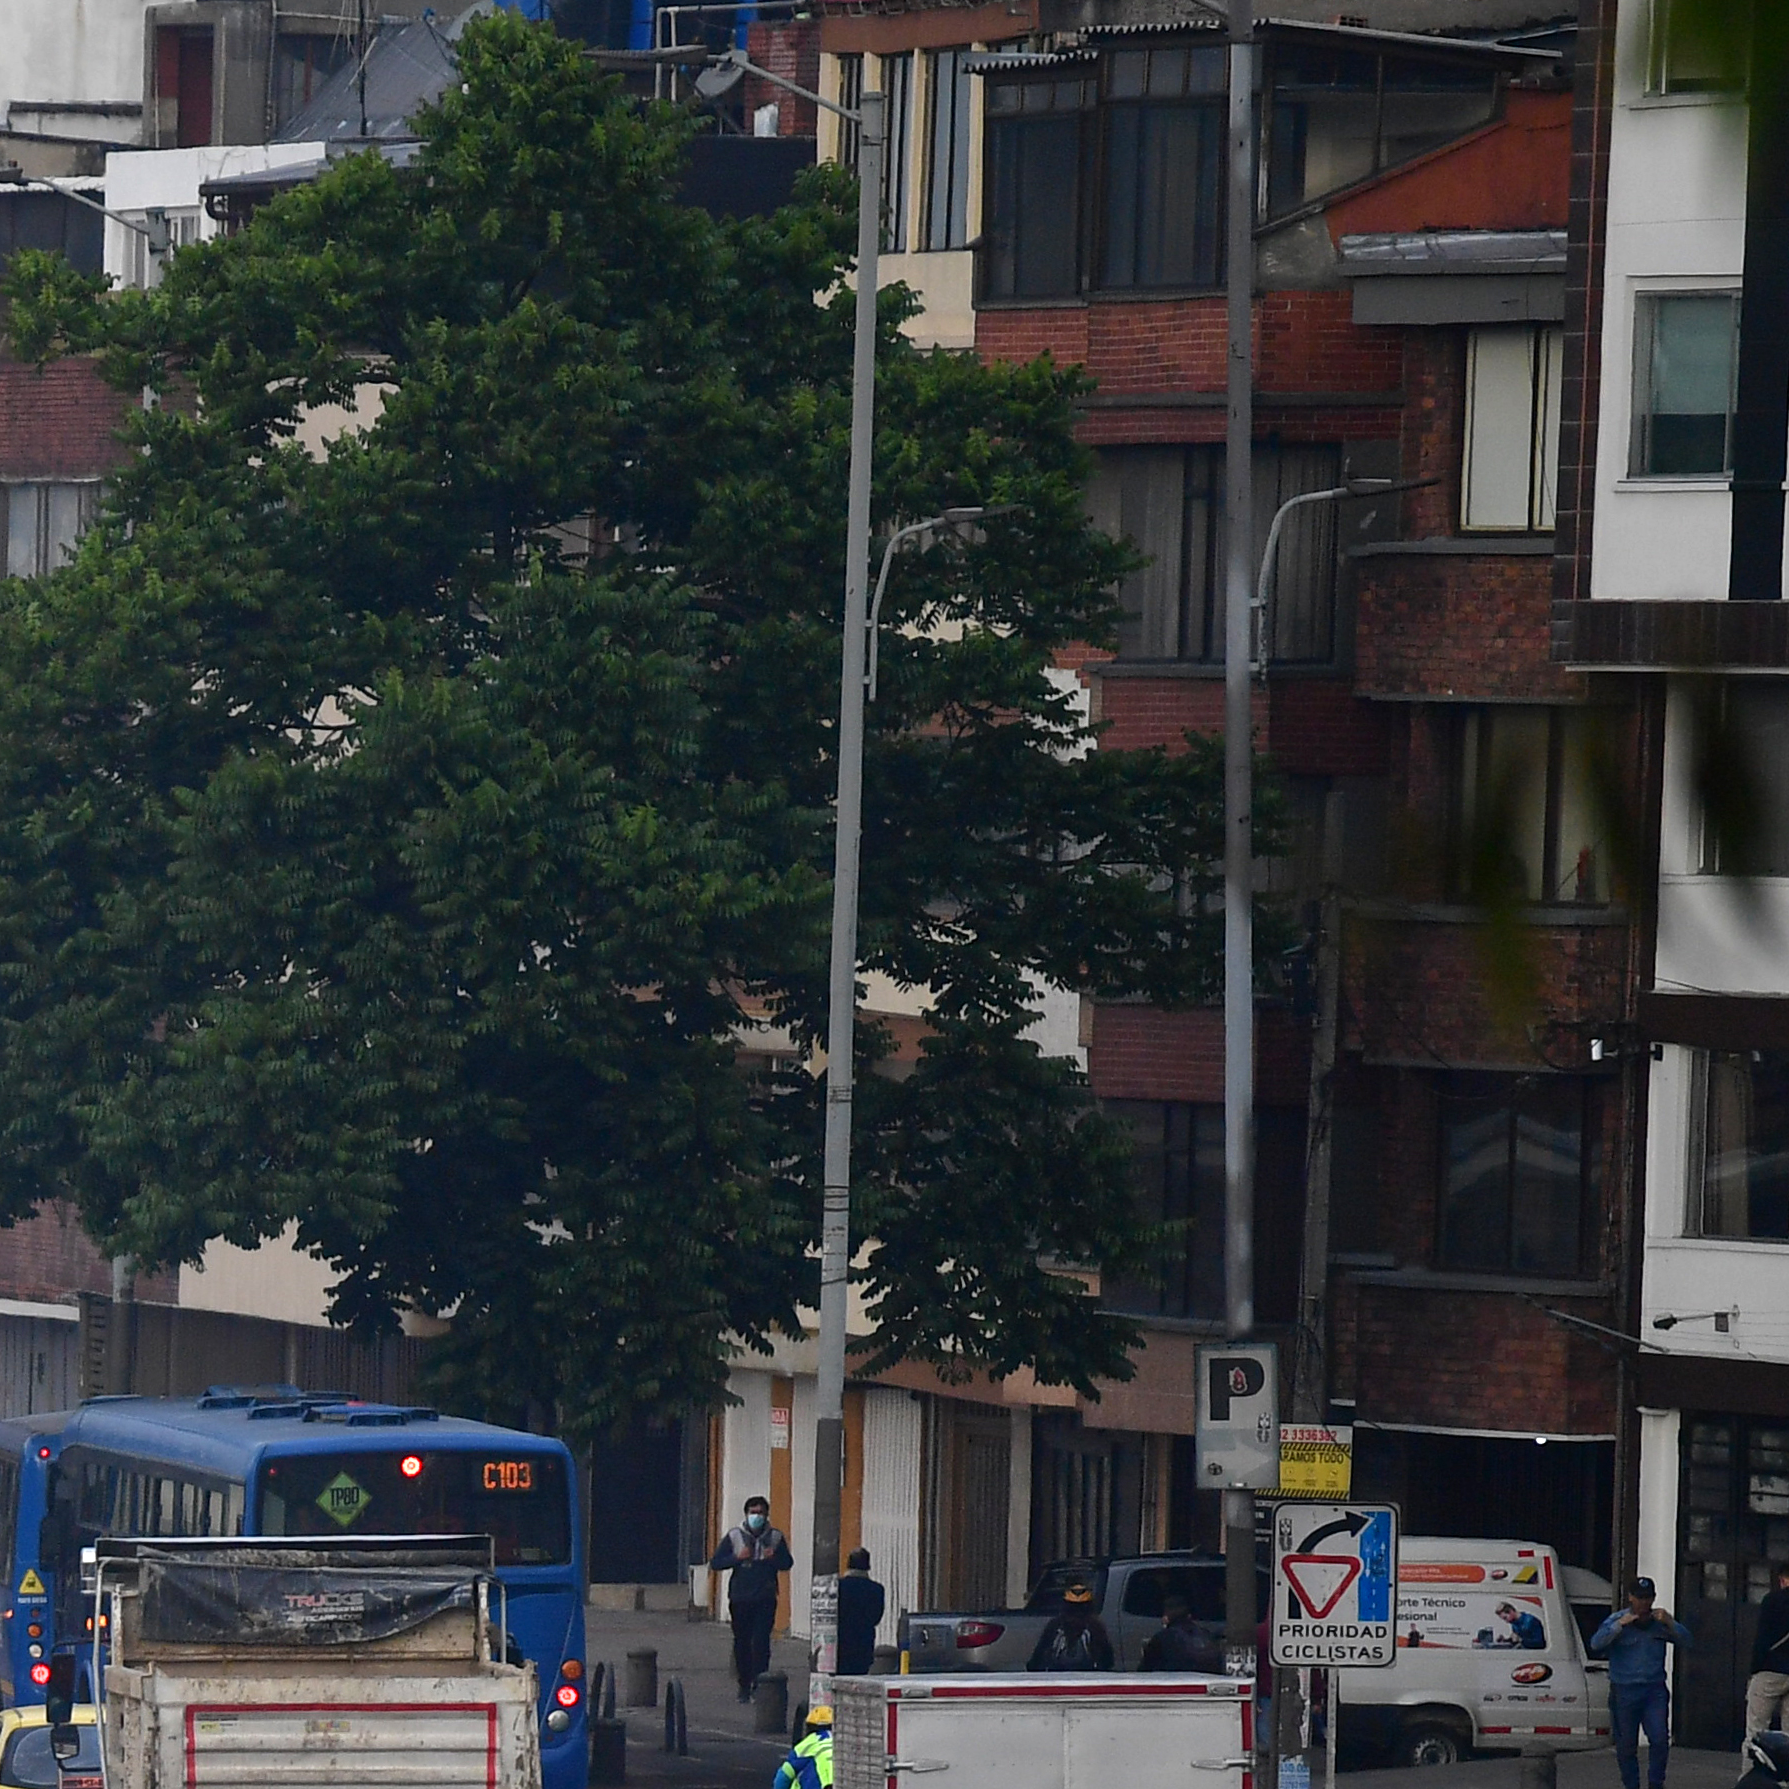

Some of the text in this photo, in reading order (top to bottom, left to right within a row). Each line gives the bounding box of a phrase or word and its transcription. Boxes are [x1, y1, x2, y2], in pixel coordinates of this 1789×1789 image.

[1209, 1358, 1265, 1421] P
[482, 1462, 533, 1489] C103
[1422, 1596, 1466, 1608] Técnico
[1279, 1624, 1387, 1639] PRIORIDAD
[1282, 1645, 1384, 1660] CICLISTAS
